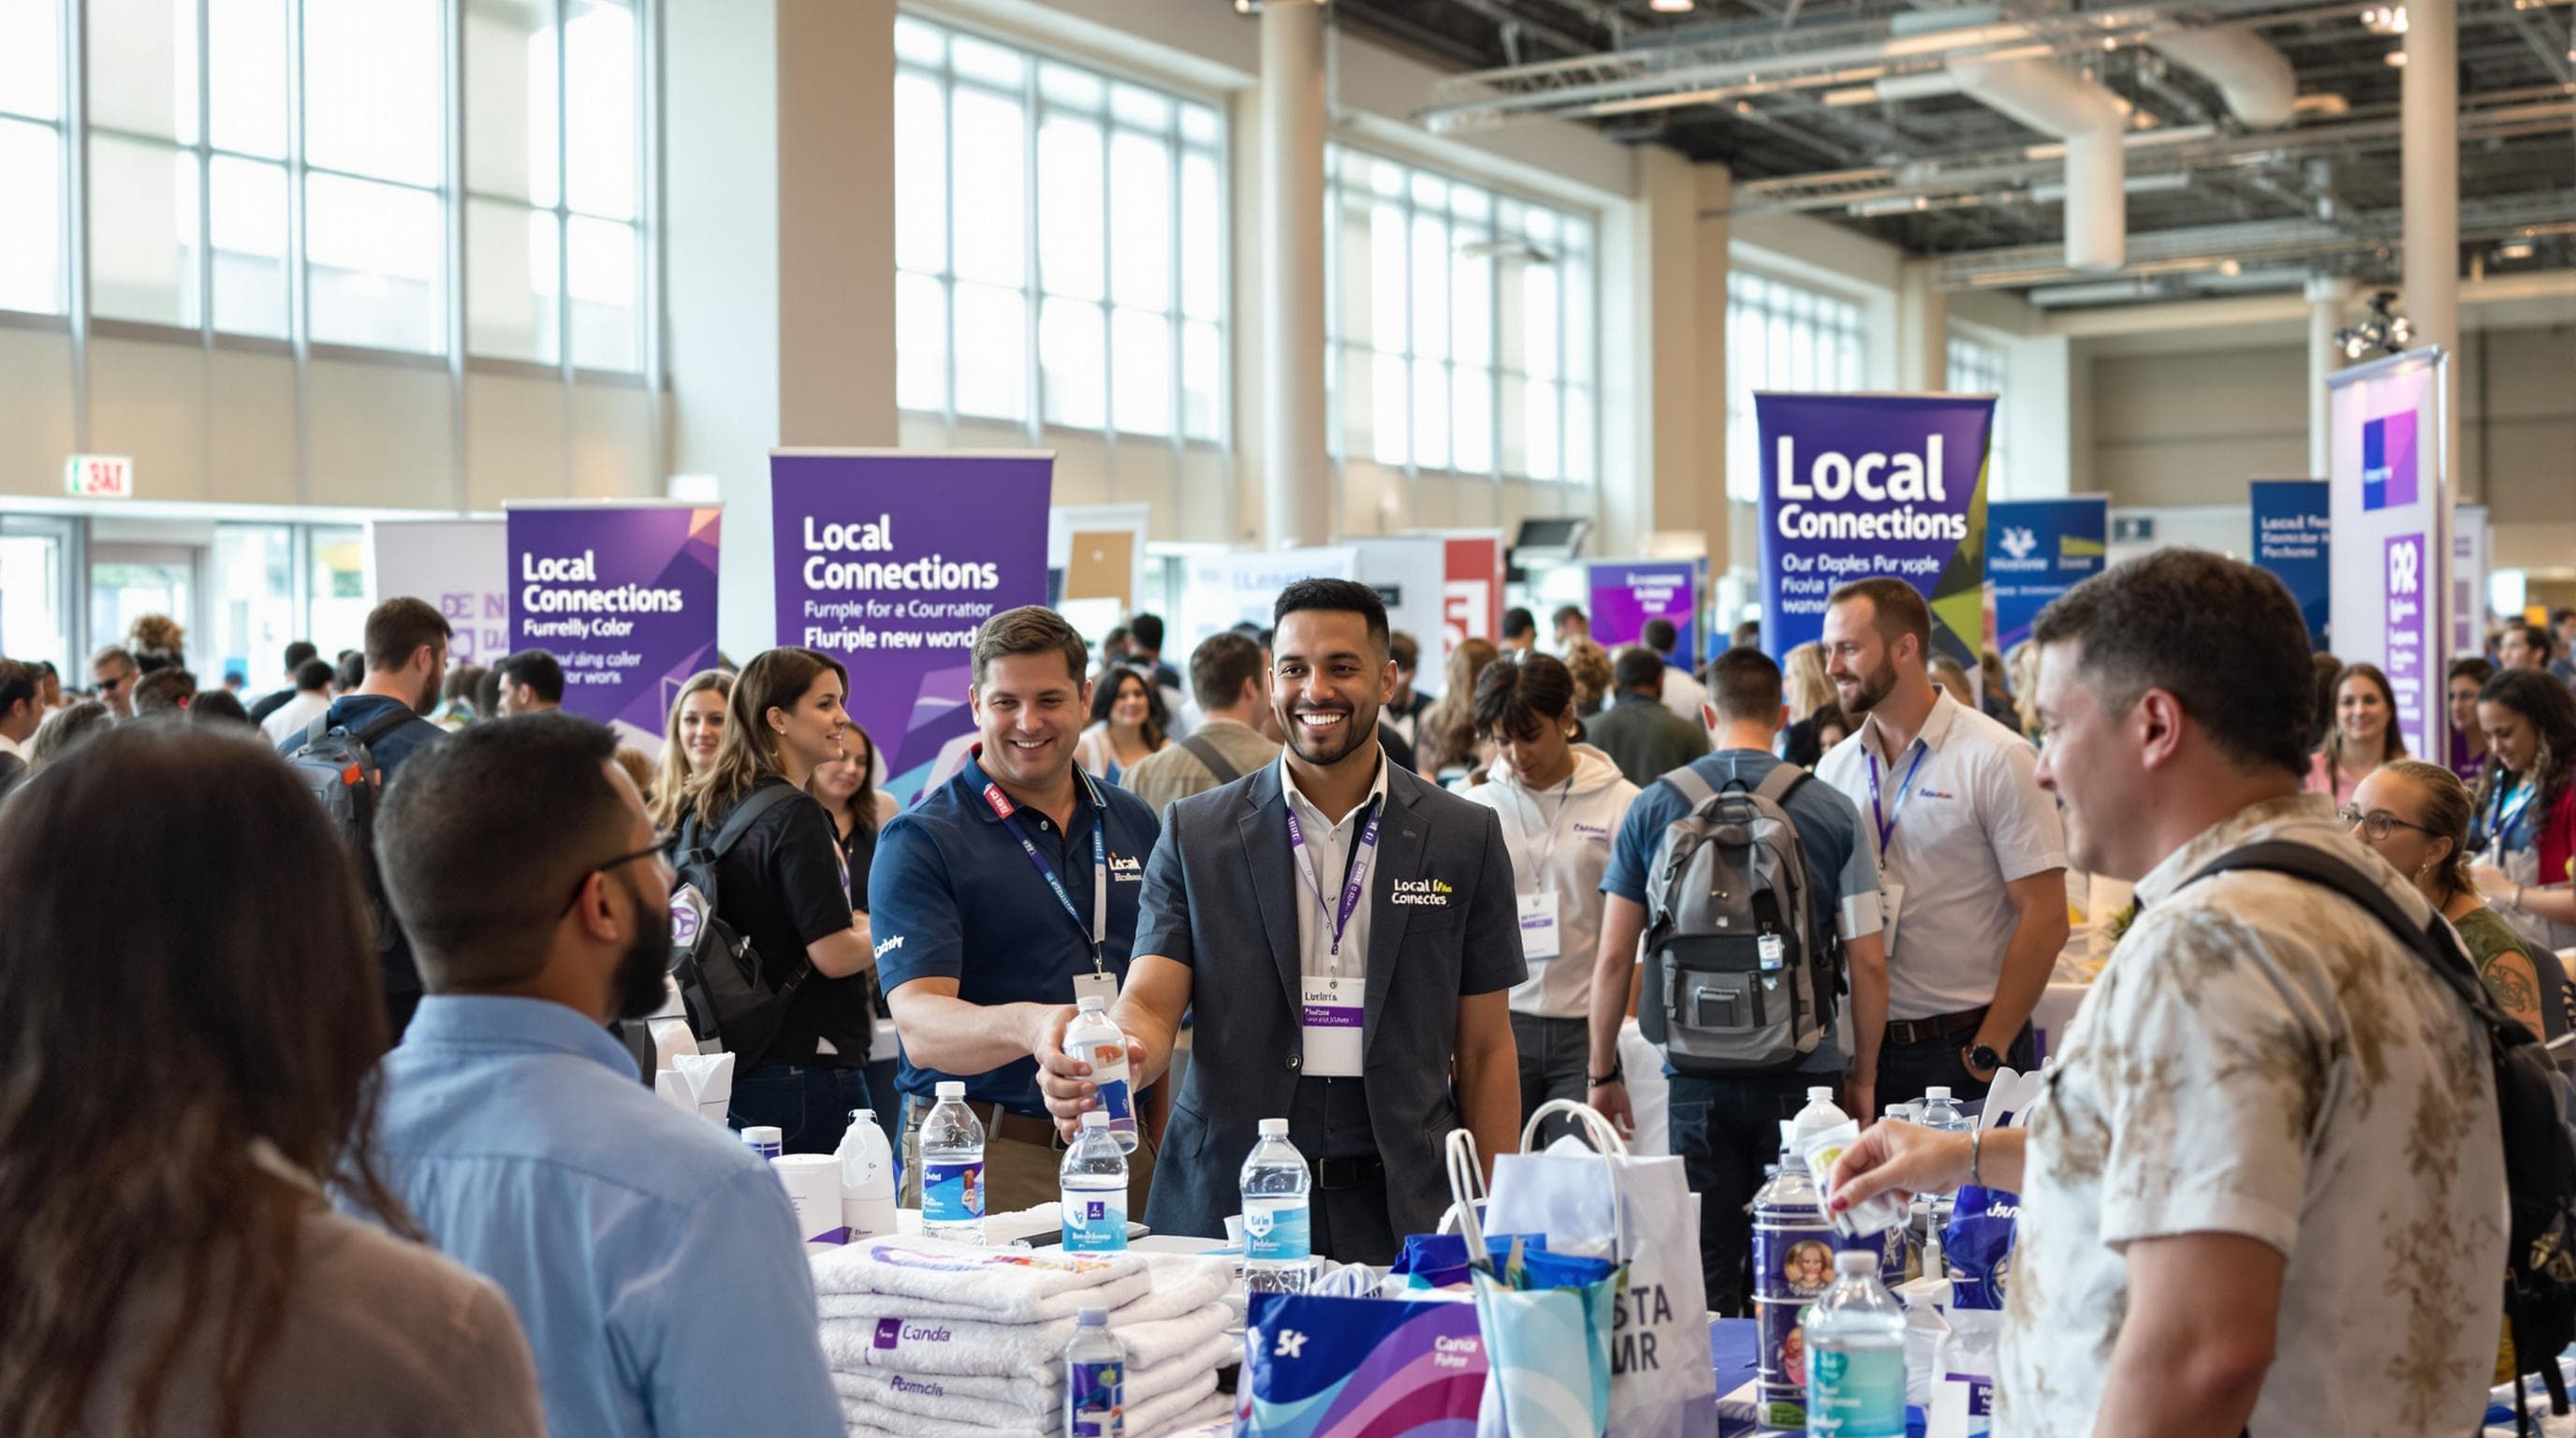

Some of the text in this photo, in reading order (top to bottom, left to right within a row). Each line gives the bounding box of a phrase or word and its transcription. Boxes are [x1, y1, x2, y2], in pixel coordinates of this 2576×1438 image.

[1778, 433, 1946, 502] Local
[803, 514, 893, 551] Local
[1778, 503, 1968, 539] Connections
[521, 549, 596, 582] Local
[802, 553, 1000, 590] Connections
[1781, 552, 1813, 572] Our
[522, 583, 683, 612] Connections
[867, 599, 890, 618] for
[591, 617, 635, 637] Color
[880, 631, 922, 649] new
[1393, 878, 1430, 892] Local
